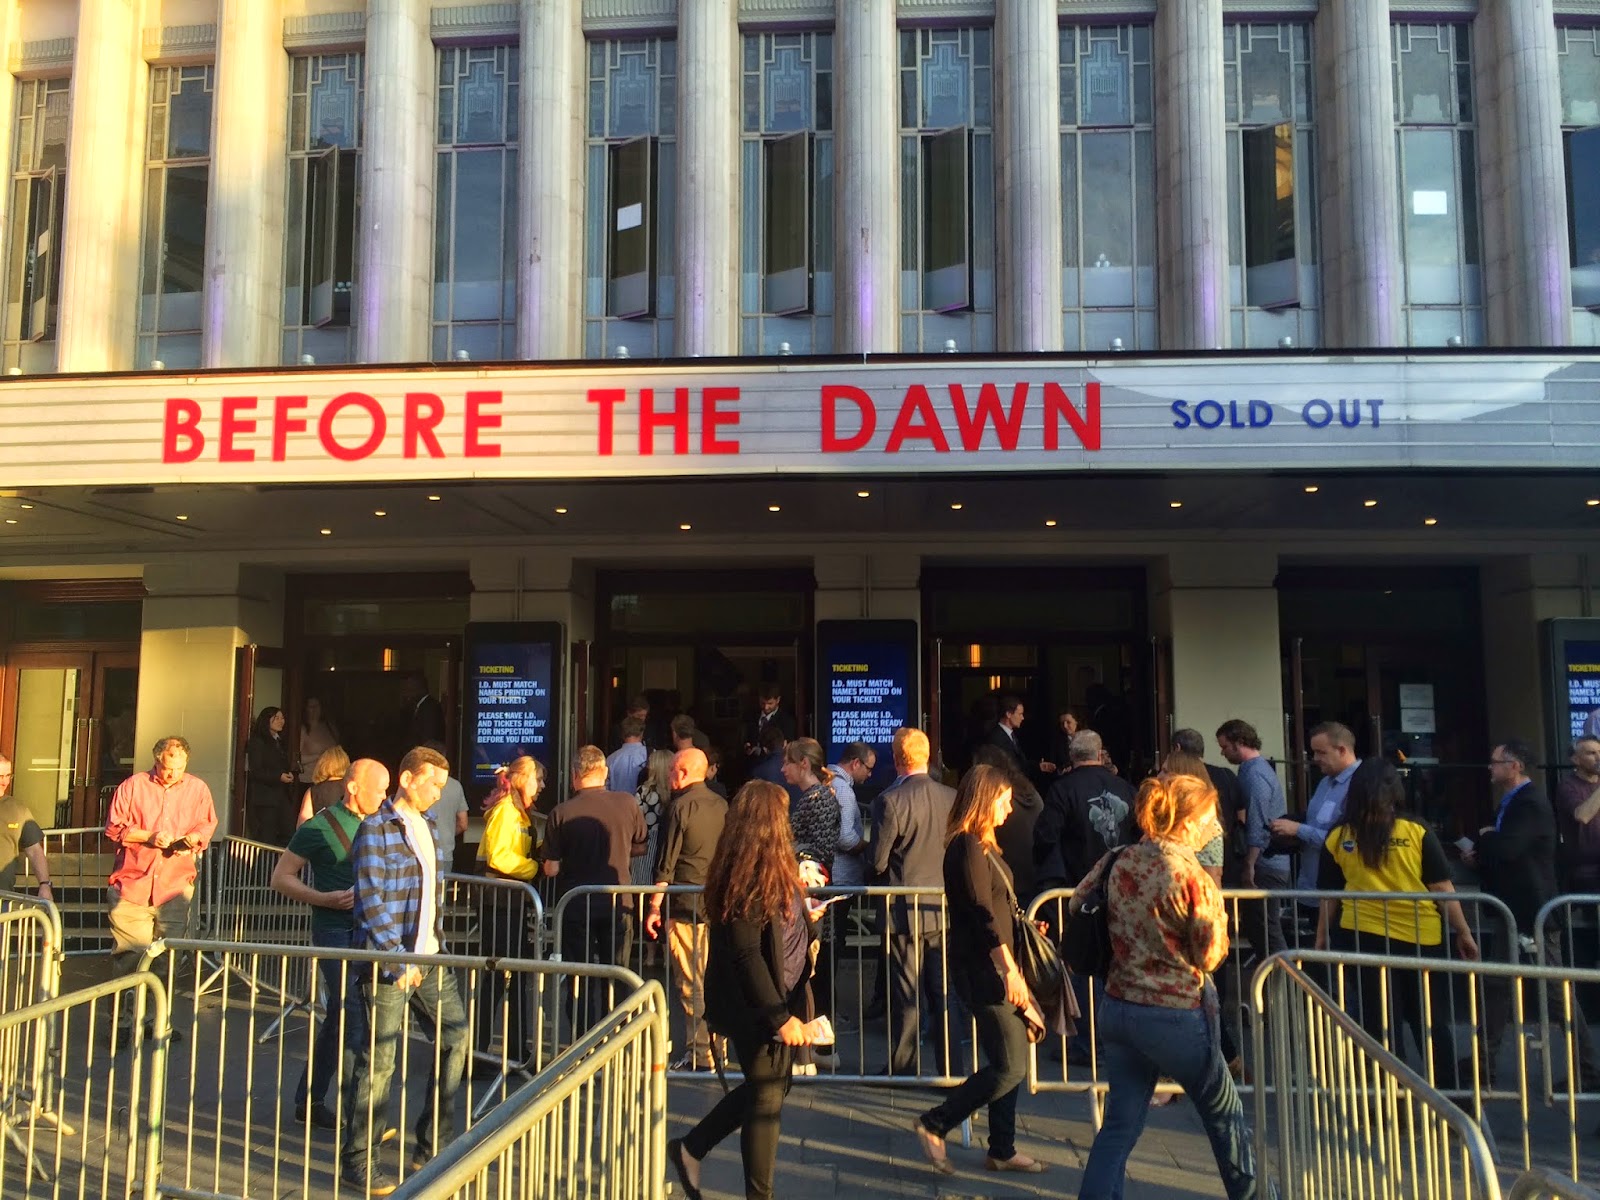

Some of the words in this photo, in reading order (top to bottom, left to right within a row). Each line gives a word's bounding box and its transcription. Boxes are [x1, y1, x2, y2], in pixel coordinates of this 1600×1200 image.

[1171, 399, 1273, 430] SOLD
[1301, 398, 1384, 429] OUT
[162, 390, 502, 463] BEFORE
[587, 387, 740, 455] THE
[821, 382, 1101, 453] DAWN
[1568, 664, 1600, 672] TICKETIN
[1570, 688, 1595, 696] NAMES
[1571, 712, 1588, 720] PLEA
